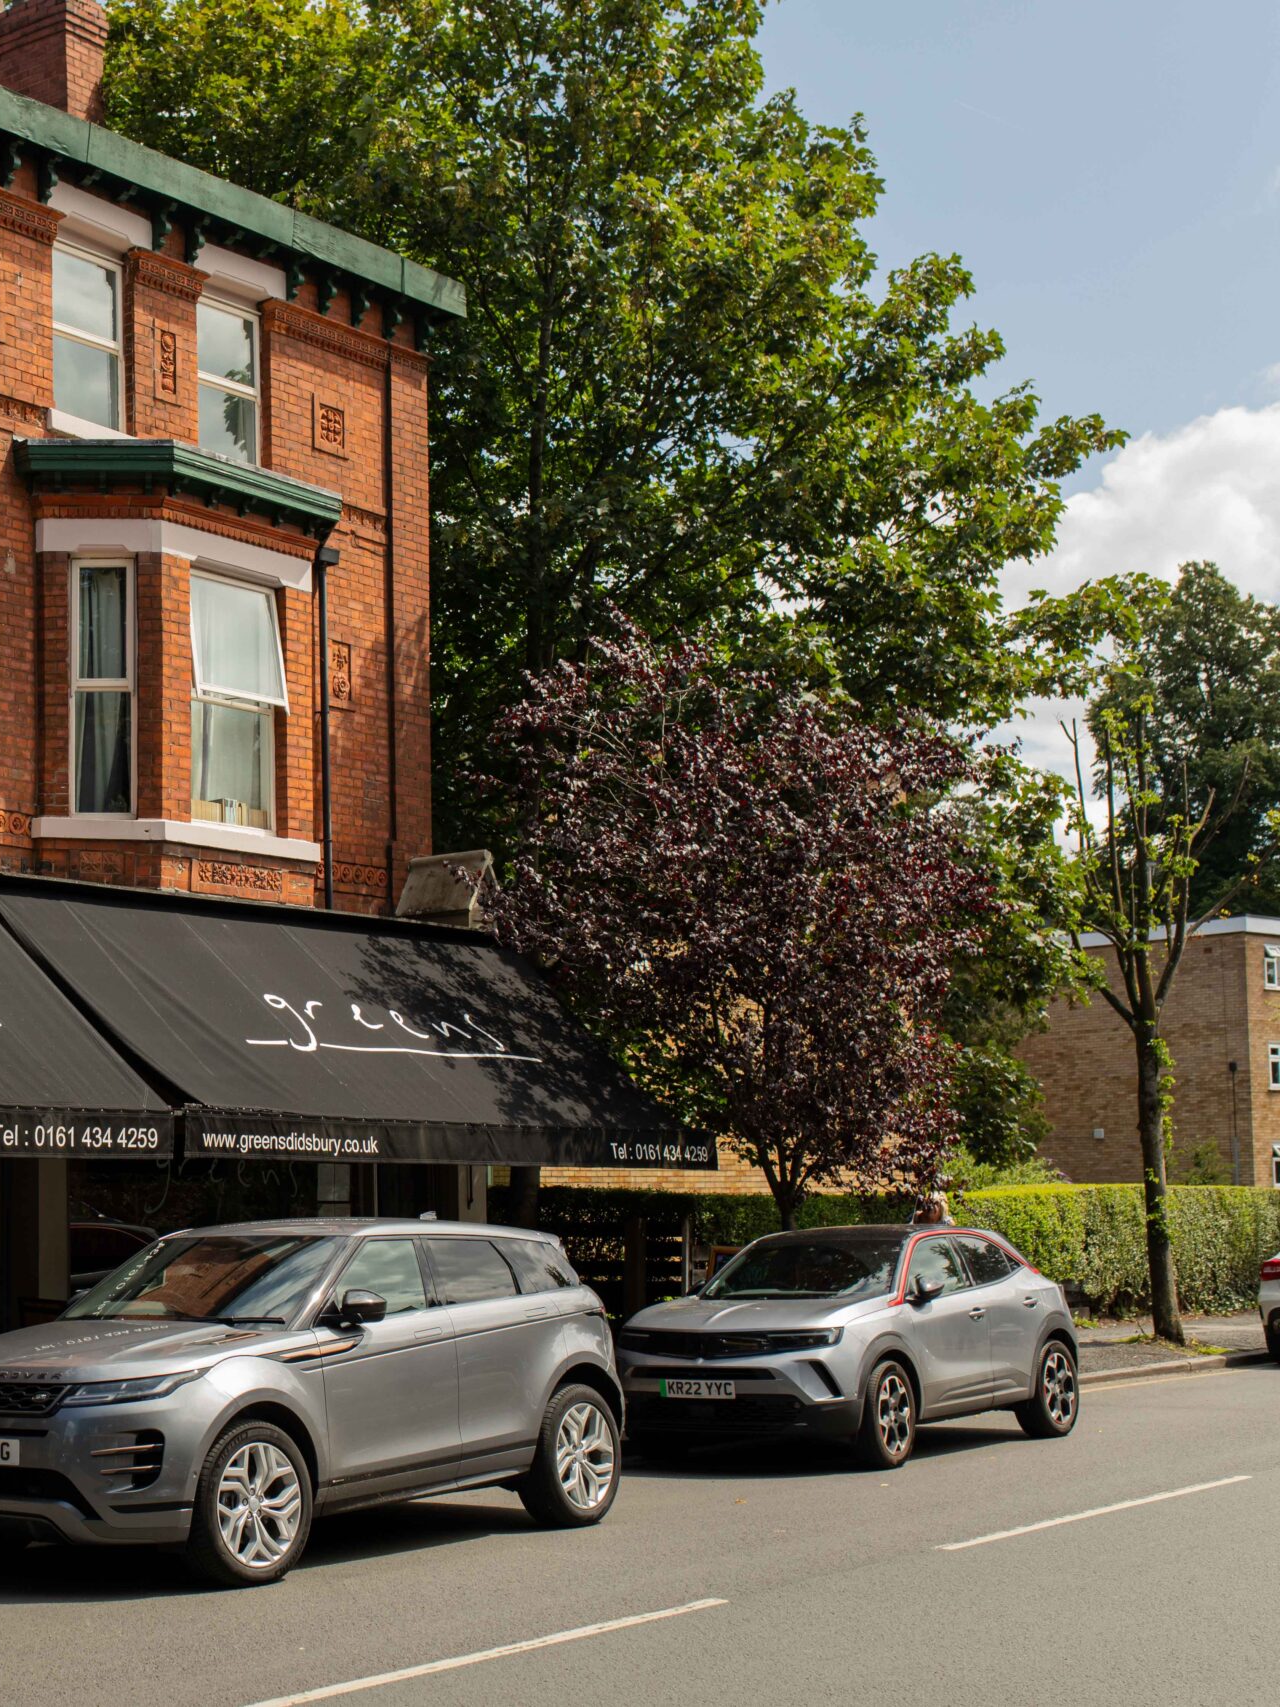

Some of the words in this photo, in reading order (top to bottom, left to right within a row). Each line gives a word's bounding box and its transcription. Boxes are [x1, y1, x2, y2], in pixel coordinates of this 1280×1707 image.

[264, 993, 506, 1052] greens
[34, 1125, 75, 1147] 0161
[81, 1127, 113, 1148] 434
[117, 1127, 158, 1149] 4259
[202, 1132, 380, 1157] www.greensdidsbury.co.uk
[610, 1142, 628, 1160] Tel
[635, 1143, 661, 1161] 0161
[663, 1145, 682, 1161] 434
[684, 1145, 709, 1163] 4259
[667, 1381, 701, 1396] KR22
[706, 1381, 733, 1397] YYC
